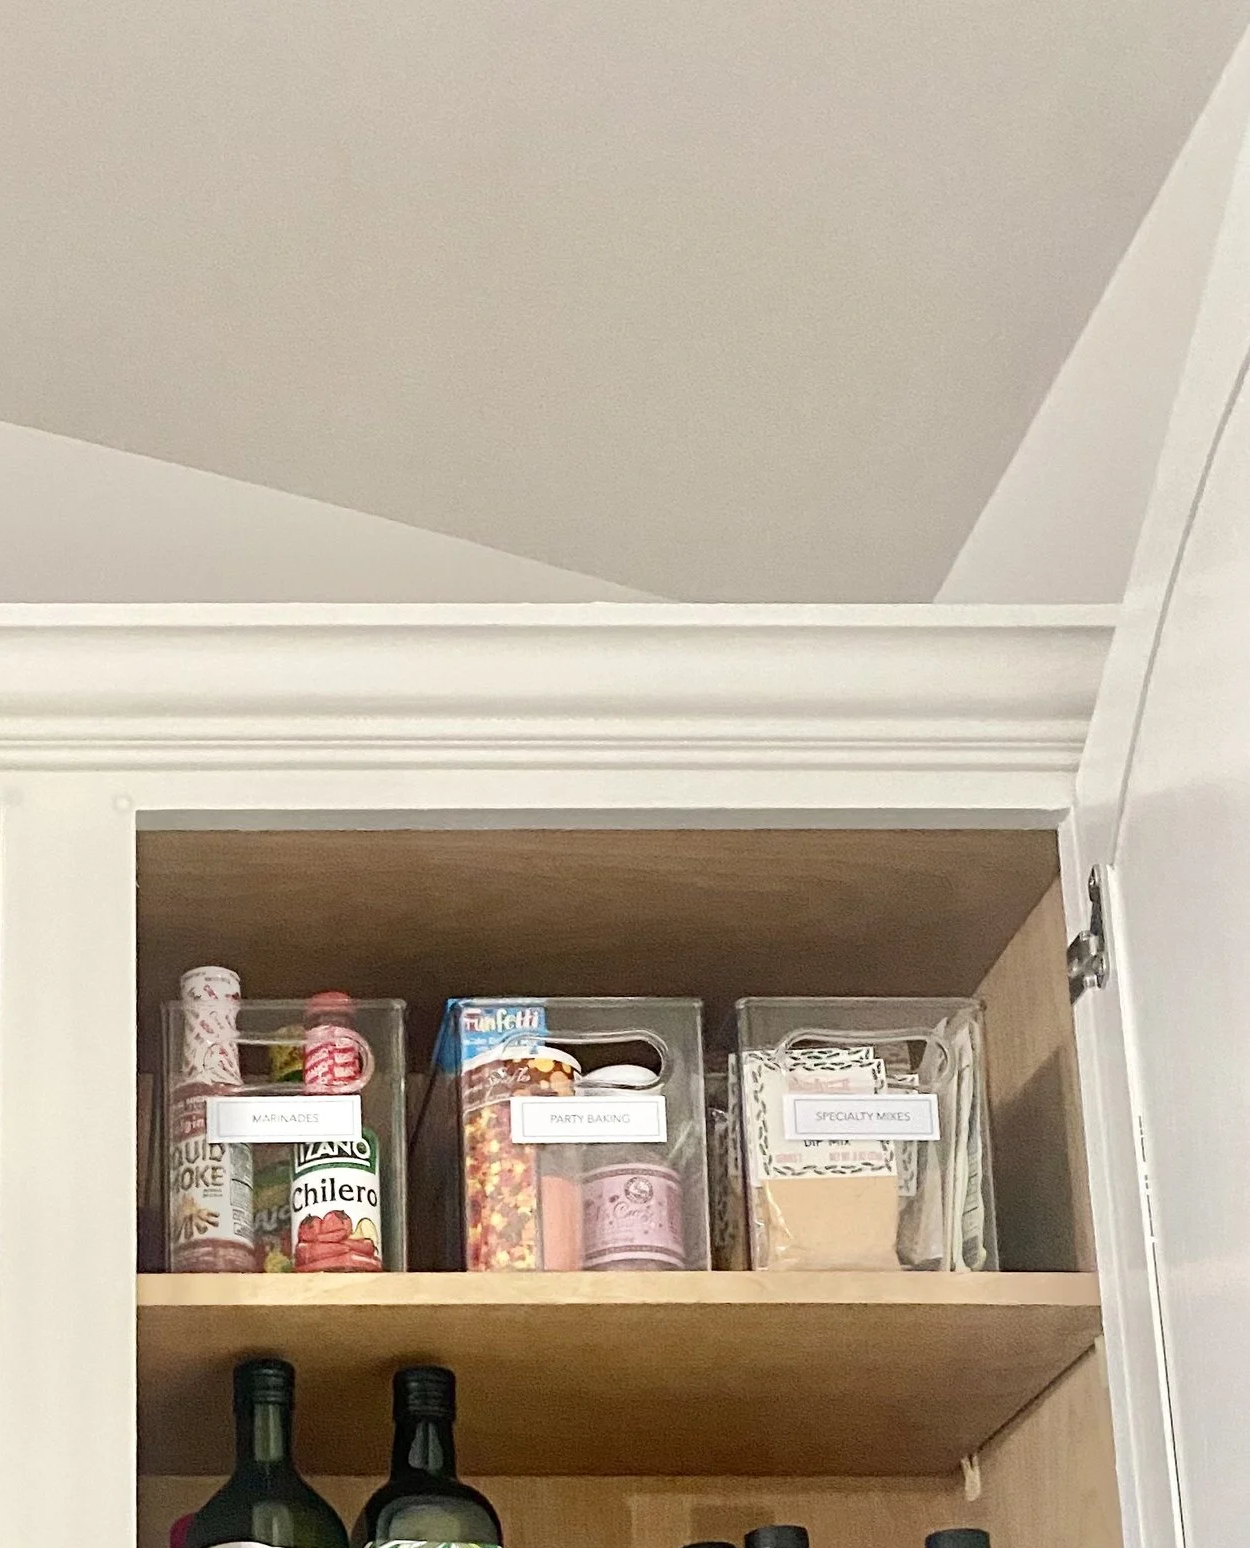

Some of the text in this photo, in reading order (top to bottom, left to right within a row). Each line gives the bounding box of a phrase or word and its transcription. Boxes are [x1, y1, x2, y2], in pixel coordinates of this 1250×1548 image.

[463, 1007, 539, 1033] Funfetti
[252, 1114, 319, 1124] MARINADES
[550, 1114, 630, 1124] PARTY BAKING
[816, 1111, 911, 1122] SPECIALTY MIXES
[292, 1177, 378, 1213] Chilero
